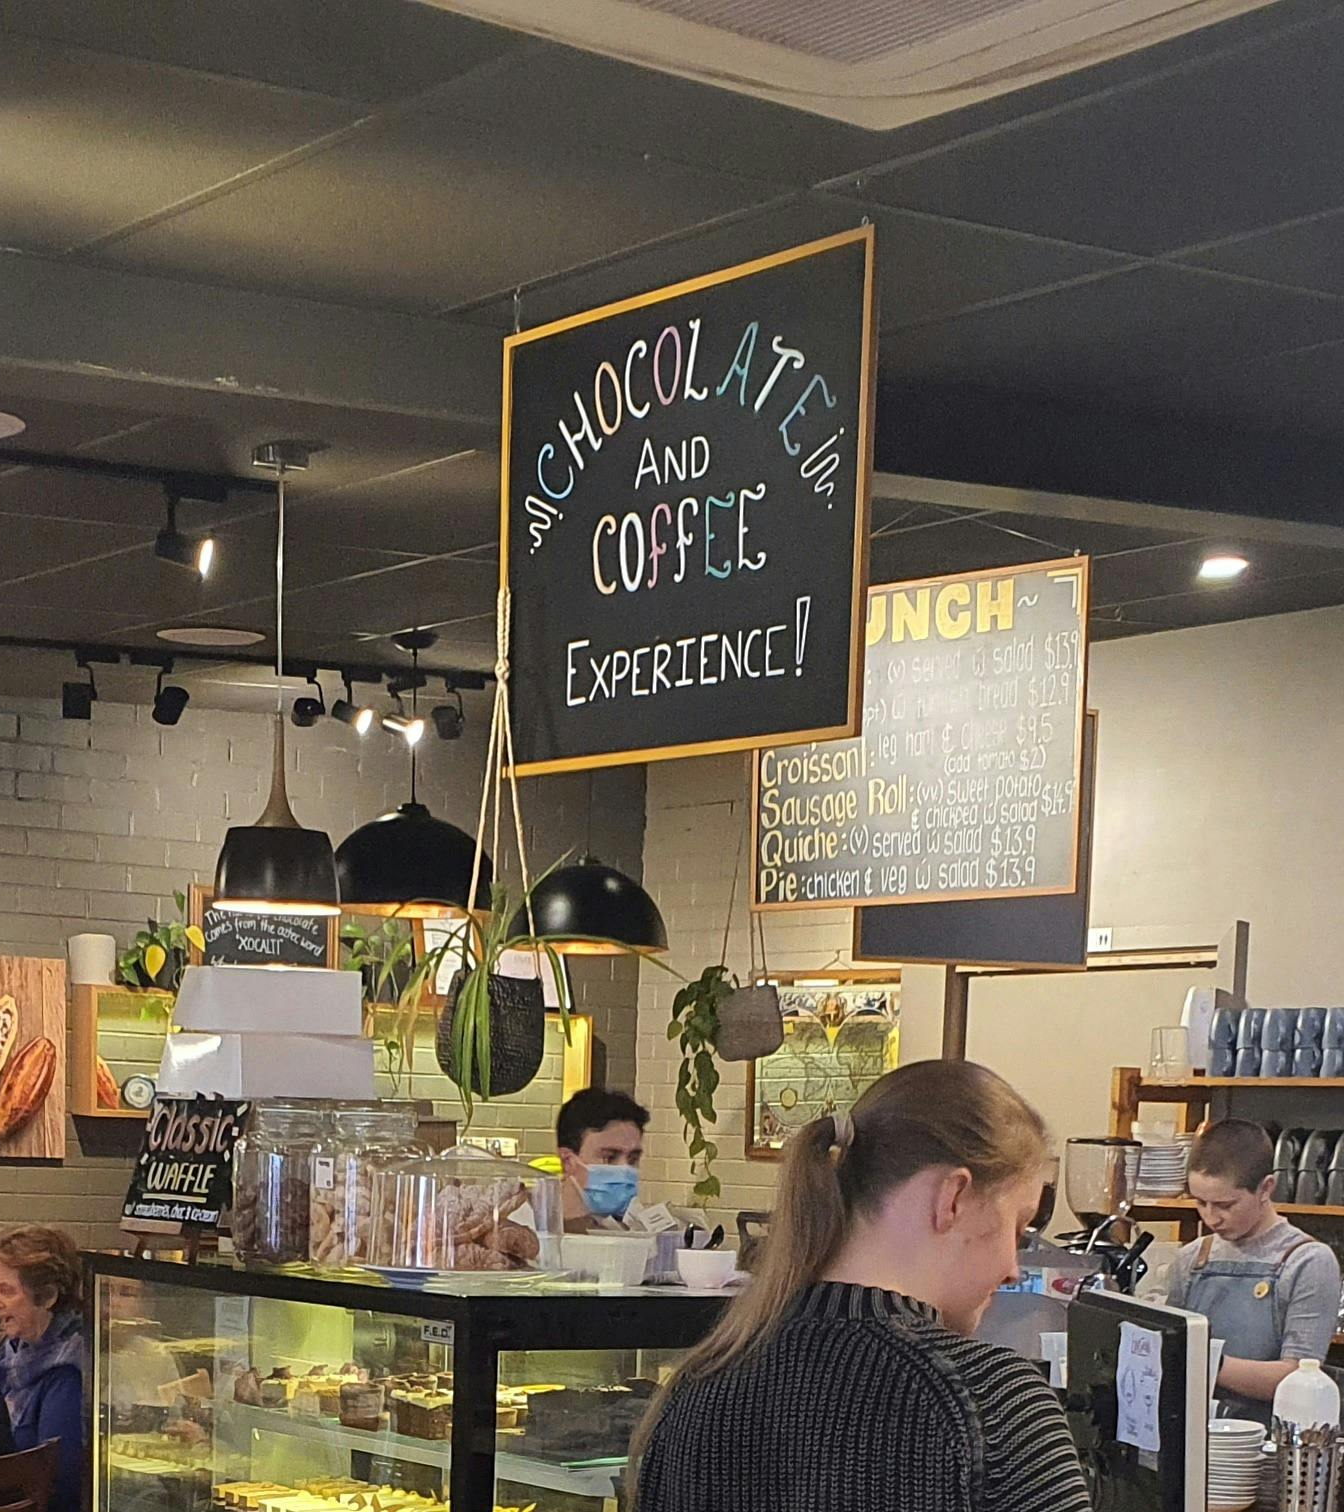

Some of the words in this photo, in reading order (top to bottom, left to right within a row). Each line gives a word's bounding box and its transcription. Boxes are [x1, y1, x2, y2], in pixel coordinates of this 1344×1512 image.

[537, 318, 837, 499] CHOCOLATE
[635, 436, 710, 490] AND
[592, 483, 766, 594] COFFEE
[567, 596, 811, 706] EXPERIENCE!
[993, 636, 1034, 674] salad
[878, 732, 898, 767] leg
[978, 747, 1016, 771] tomato
[1020, 743, 1047, 771] $2)
[761, 785, 858, 830] Sausage
[995, 773, 1042, 801] potato
[925, 804, 978, 829] chickpea
[1000, 796, 1038, 823] salad
[872, 829, 921, 858] served
[944, 824, 983, 854] salad
[990, 824, 1036, 858] $13.9
[806, 869, 860, 900] chicken
[880, 864, 907, 896] veg
[939, 857, 980, 889] salad
[985, 856, 1036, 888] $13.9
[205, 910, 227, 926] The
[205, 920, 233, 943] comes
[234, 917, 256, 933] from
[260, 919, 276, 935] the
[277, 925, 300, 945] aztec
[300, 936, 326, 957] word
[149, 1101, 235, 1154] Classic
[146, 1161, 217, 1194] WAFFLE
